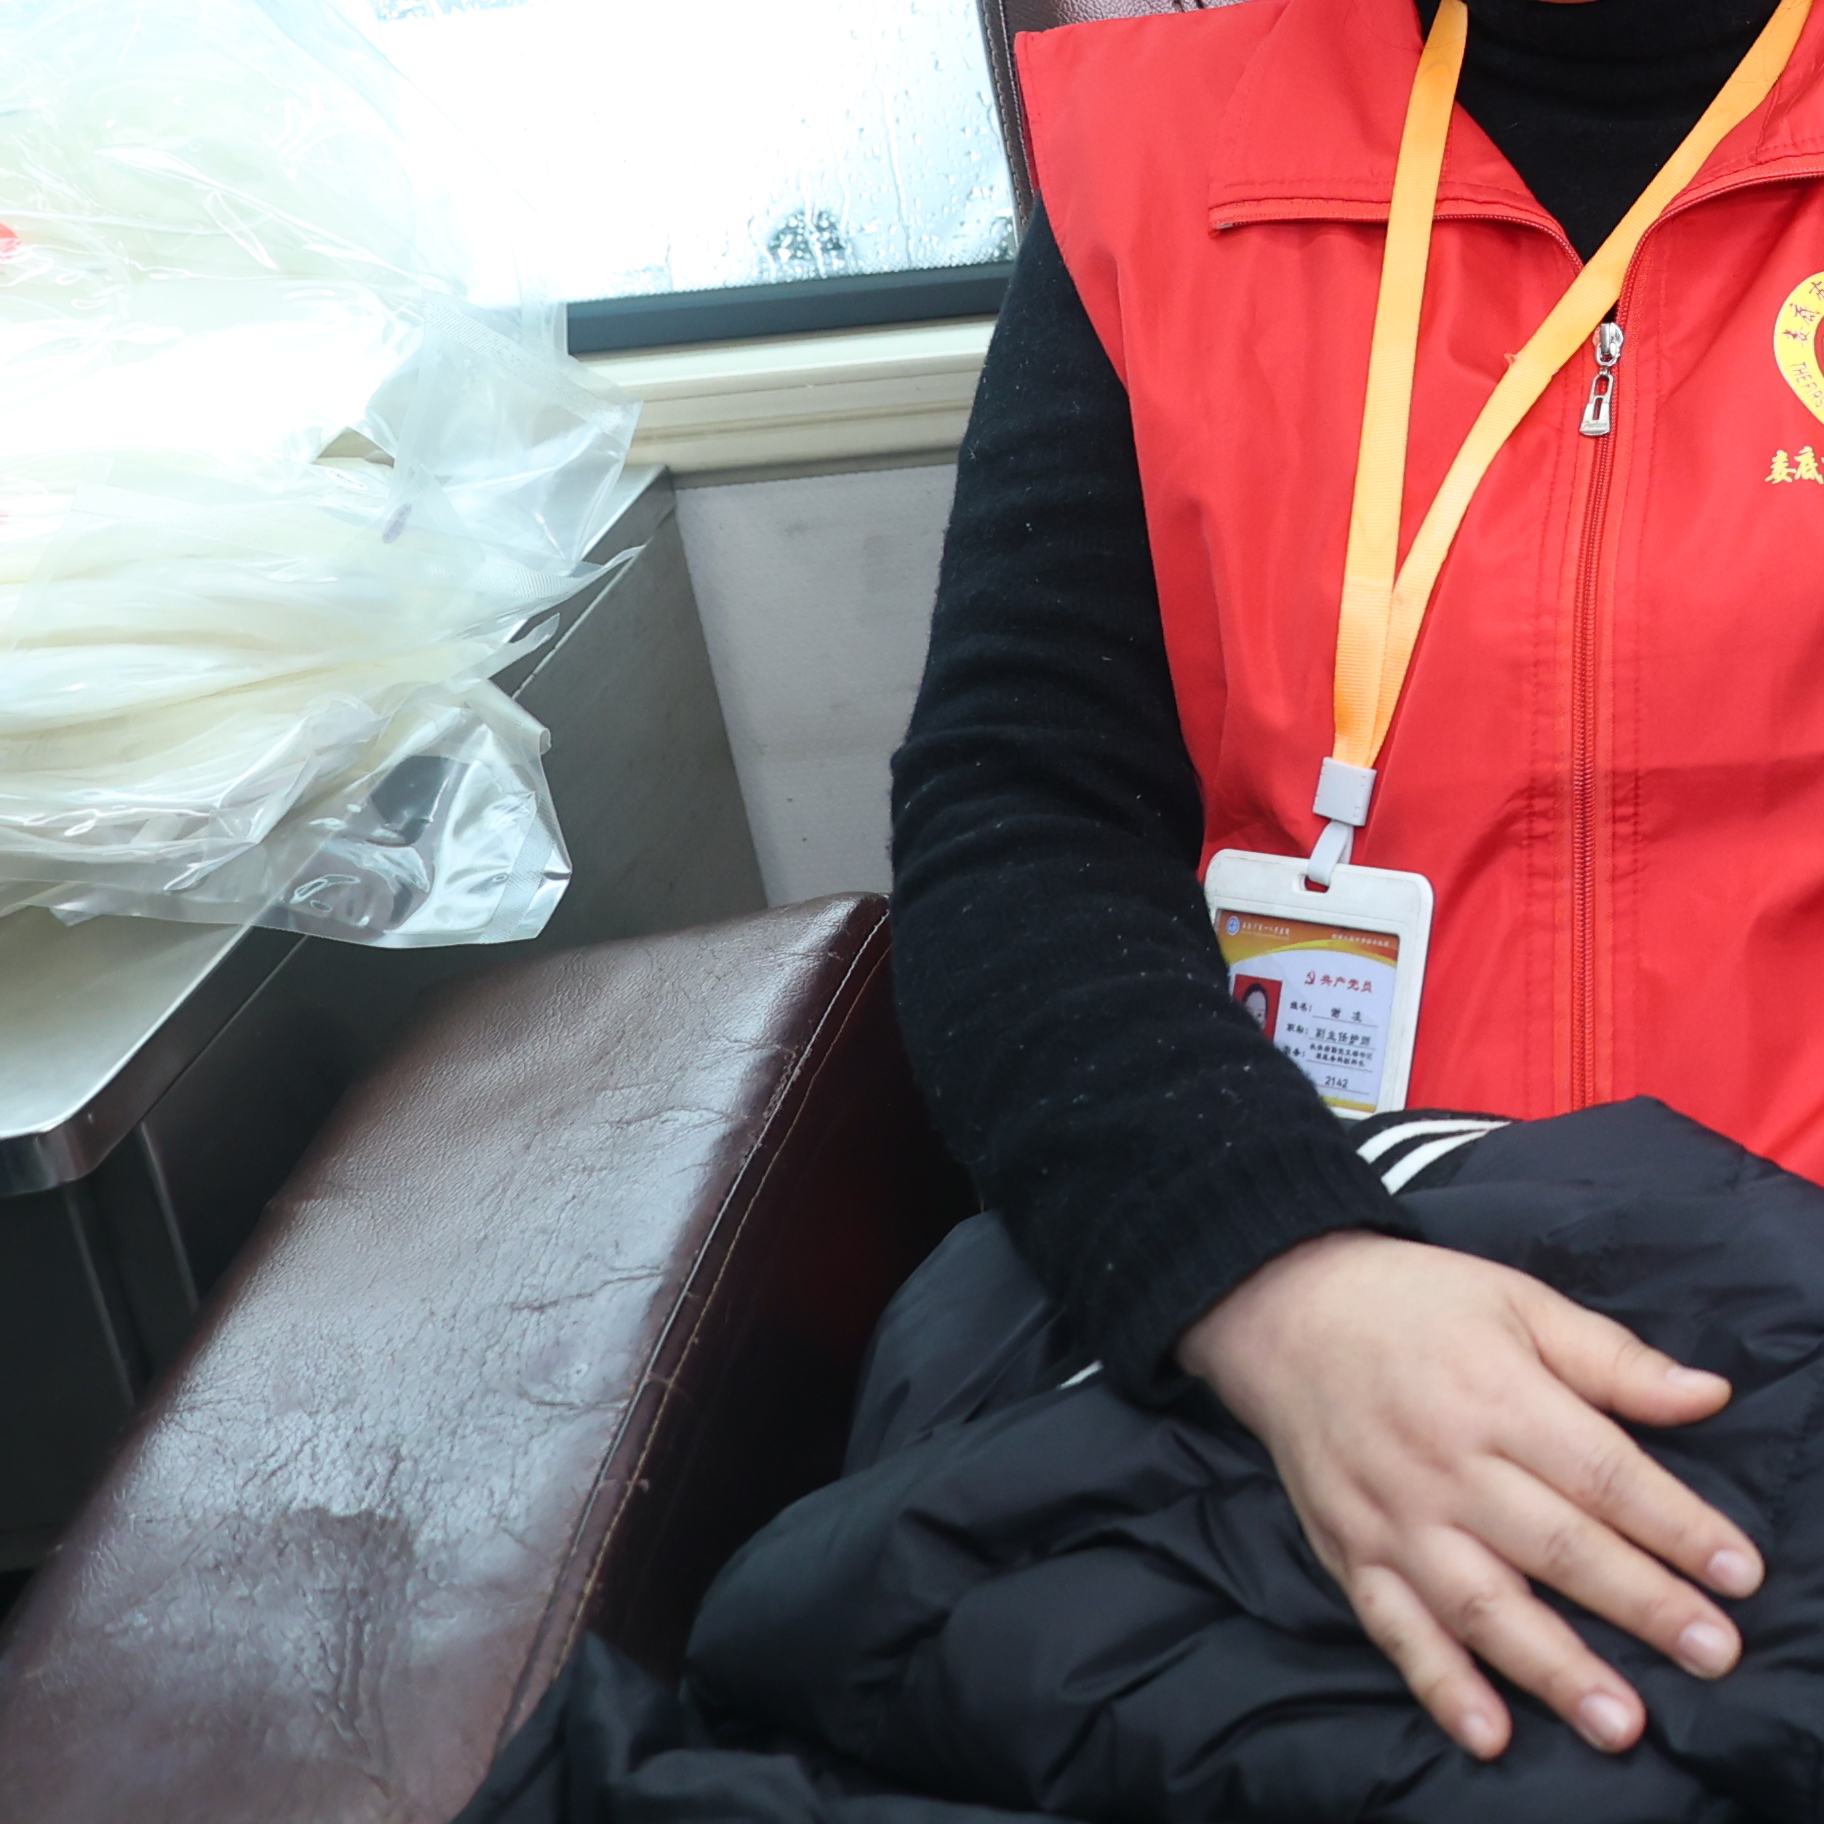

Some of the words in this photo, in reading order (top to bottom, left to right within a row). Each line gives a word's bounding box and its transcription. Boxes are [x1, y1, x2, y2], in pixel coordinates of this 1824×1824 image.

[1320, 973, 1373, 994] 共产党员
[1325, 1076, 1348, 1089] 2142
